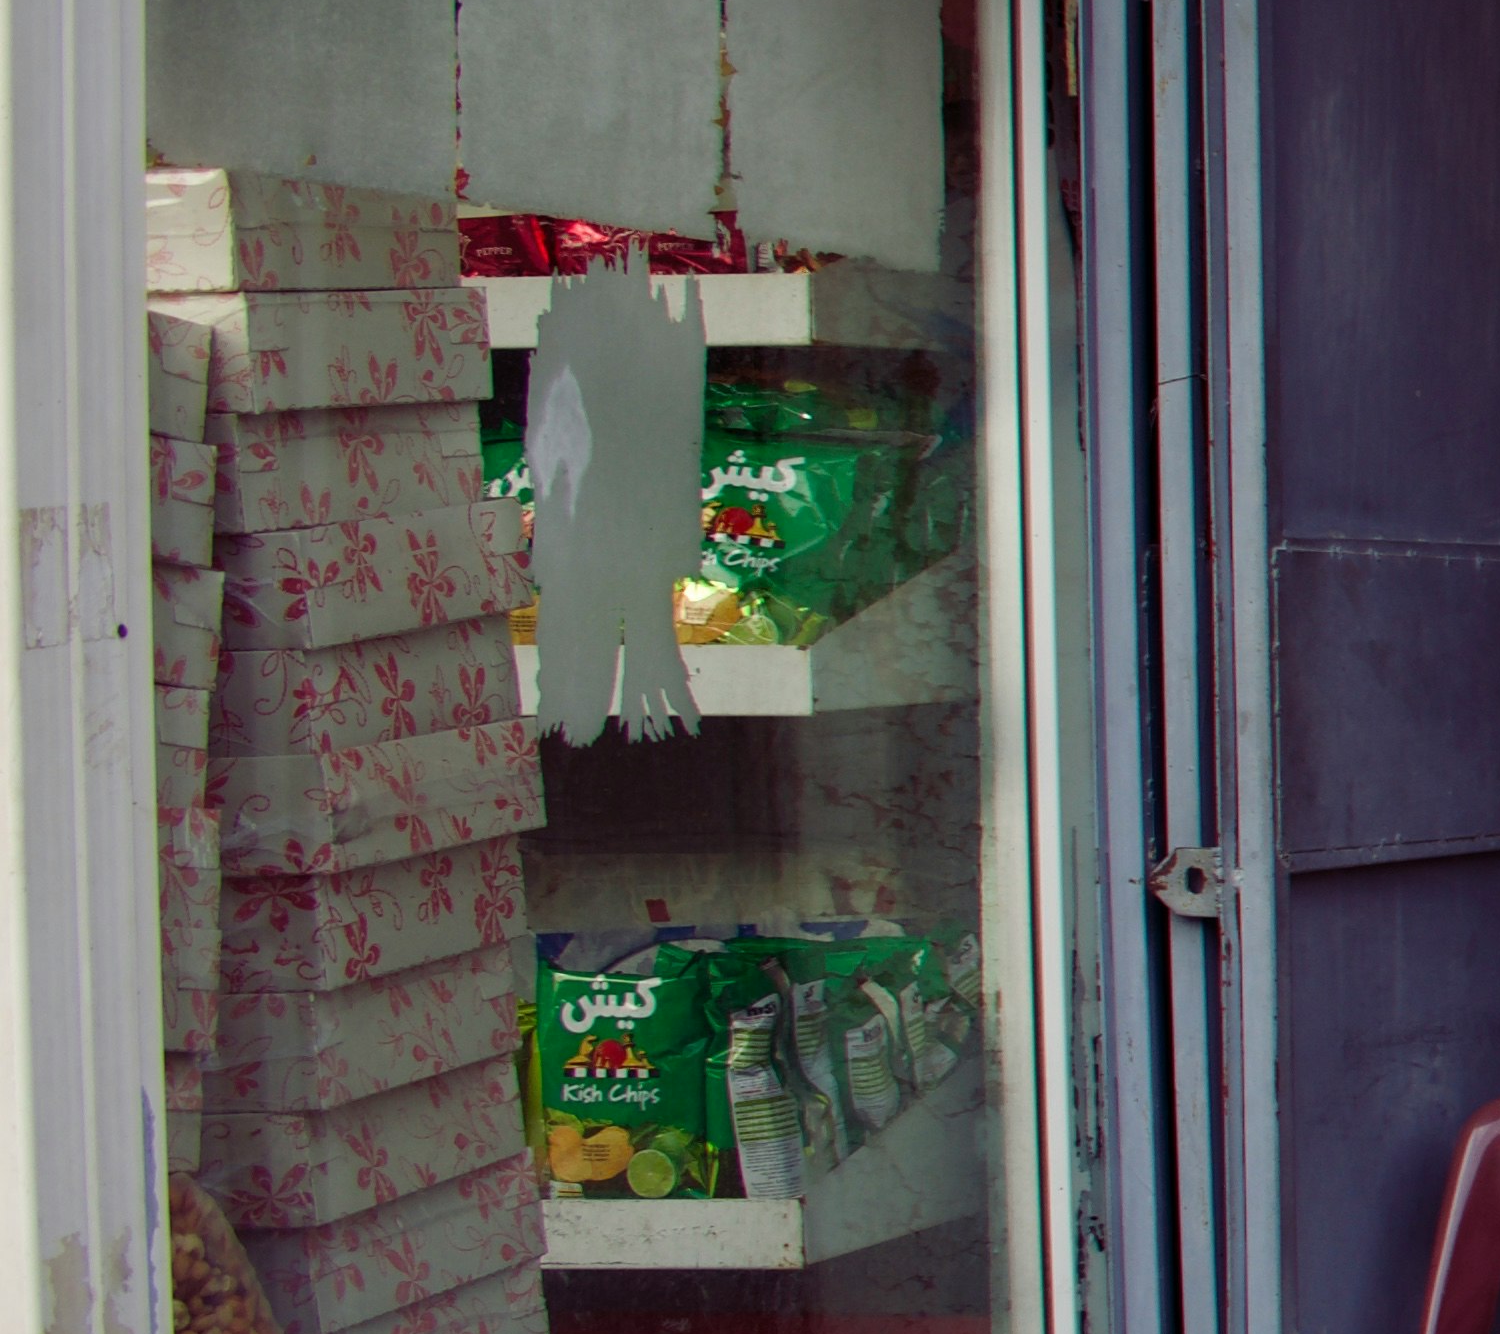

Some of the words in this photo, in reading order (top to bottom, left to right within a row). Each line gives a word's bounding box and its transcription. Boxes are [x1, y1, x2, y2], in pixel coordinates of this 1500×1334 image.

[476, 246, 513, 258] PEPPER
[723, 547, 780, 574] Chips
[561, 973, 663, 1034] كيش
[562, 1082, 604, 1104] Kish
[607, 1080, 661, 1112] Chips
